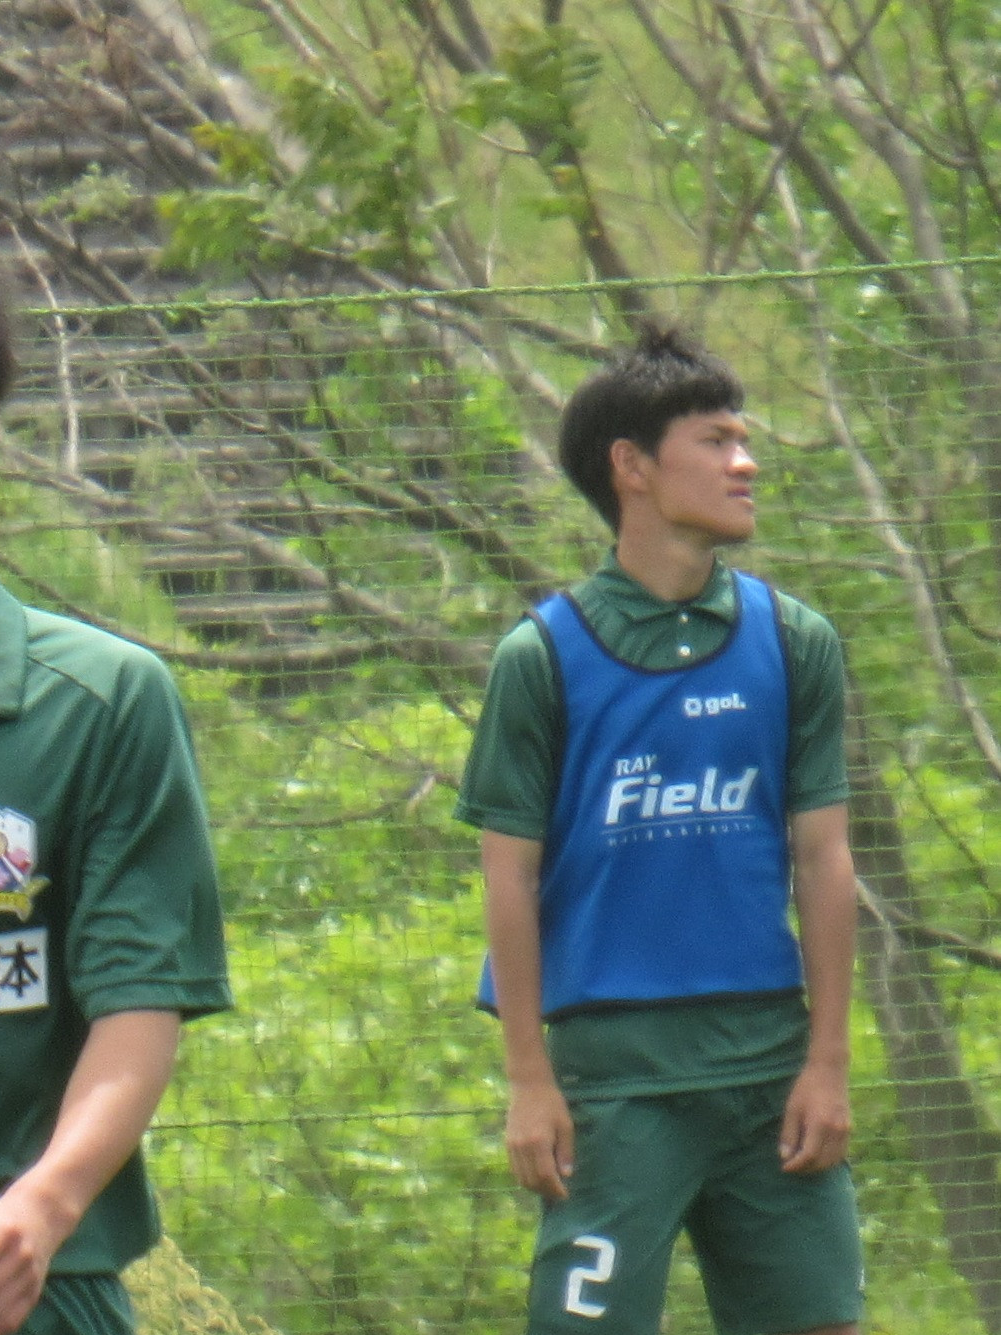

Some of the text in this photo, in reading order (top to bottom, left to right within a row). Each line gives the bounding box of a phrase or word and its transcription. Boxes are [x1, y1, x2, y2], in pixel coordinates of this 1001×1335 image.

[605, 766, 759, 825] Field
[616, 755, 657, 777] RAY
[565, 1235, 615, 1318] 2
